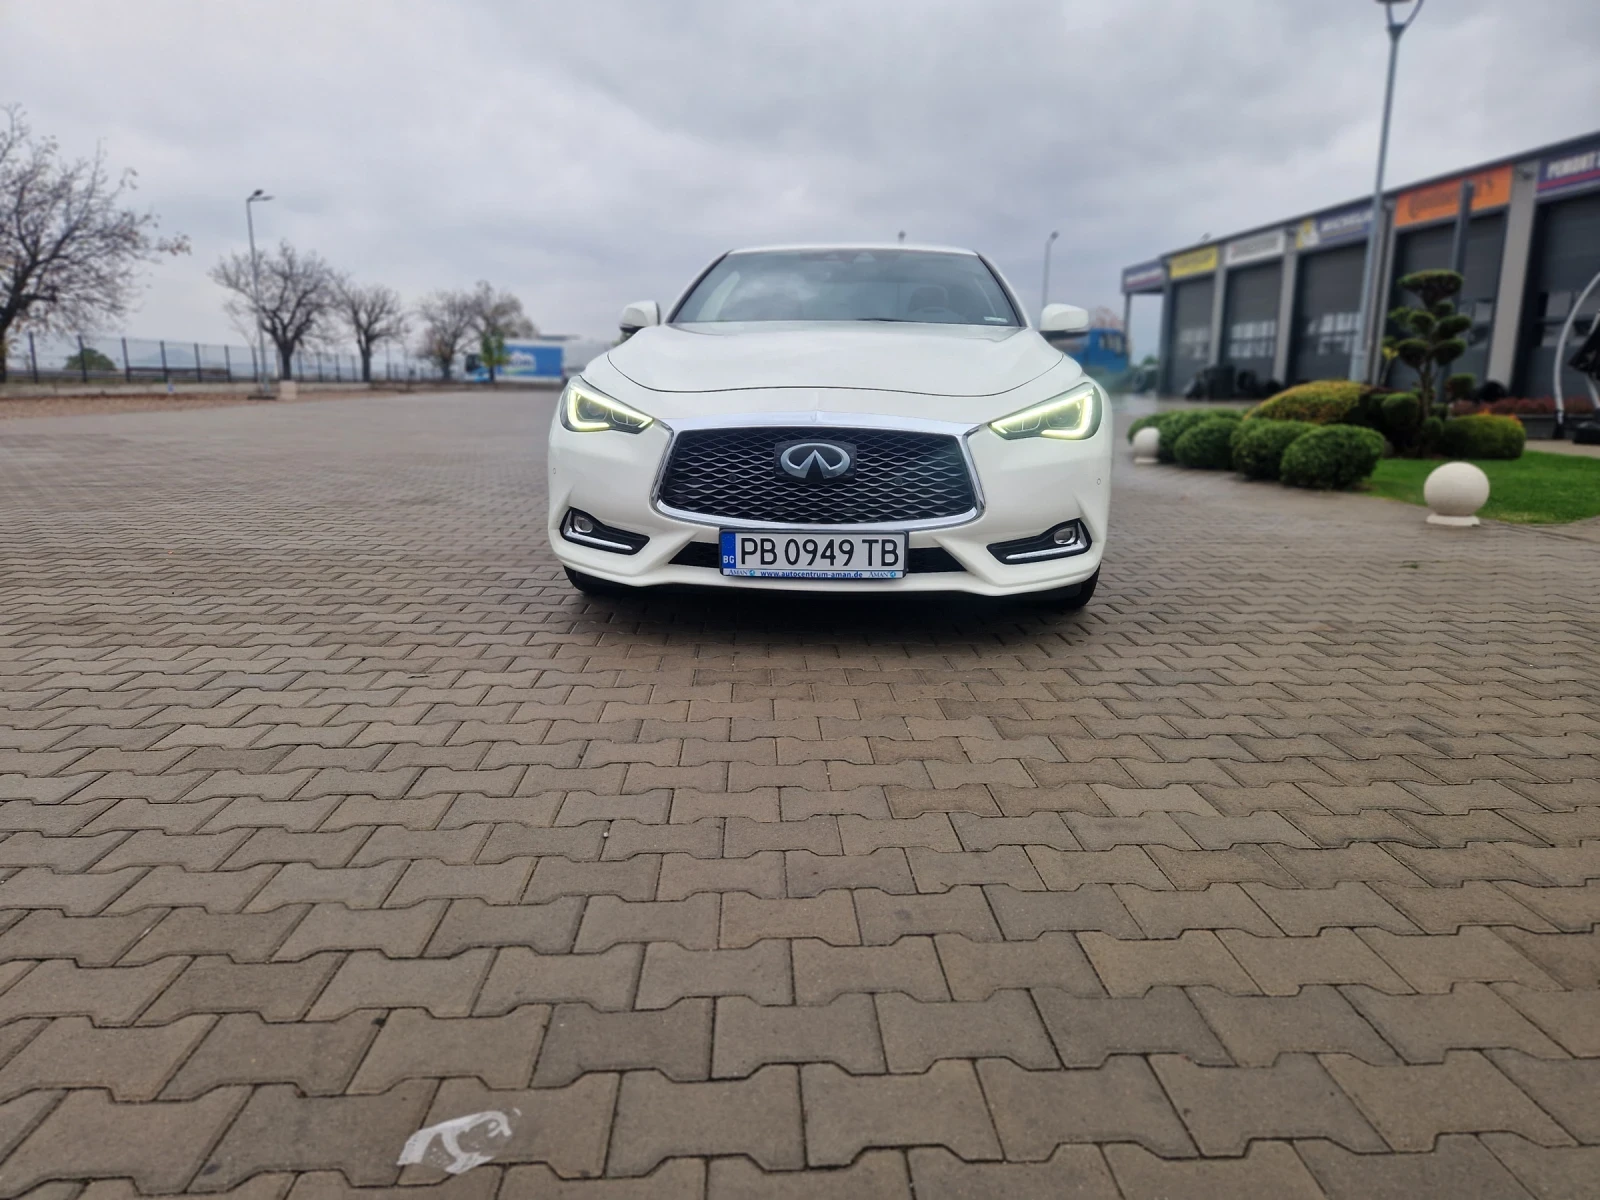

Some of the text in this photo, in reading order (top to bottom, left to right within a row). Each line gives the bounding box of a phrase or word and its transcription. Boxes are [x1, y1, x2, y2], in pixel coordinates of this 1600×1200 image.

[740, 537, 899, 567] PB 0949 TB
[722, 555, 735, 564] BG
[760, 570, 863, 578] www.autocentrum-aman.de
